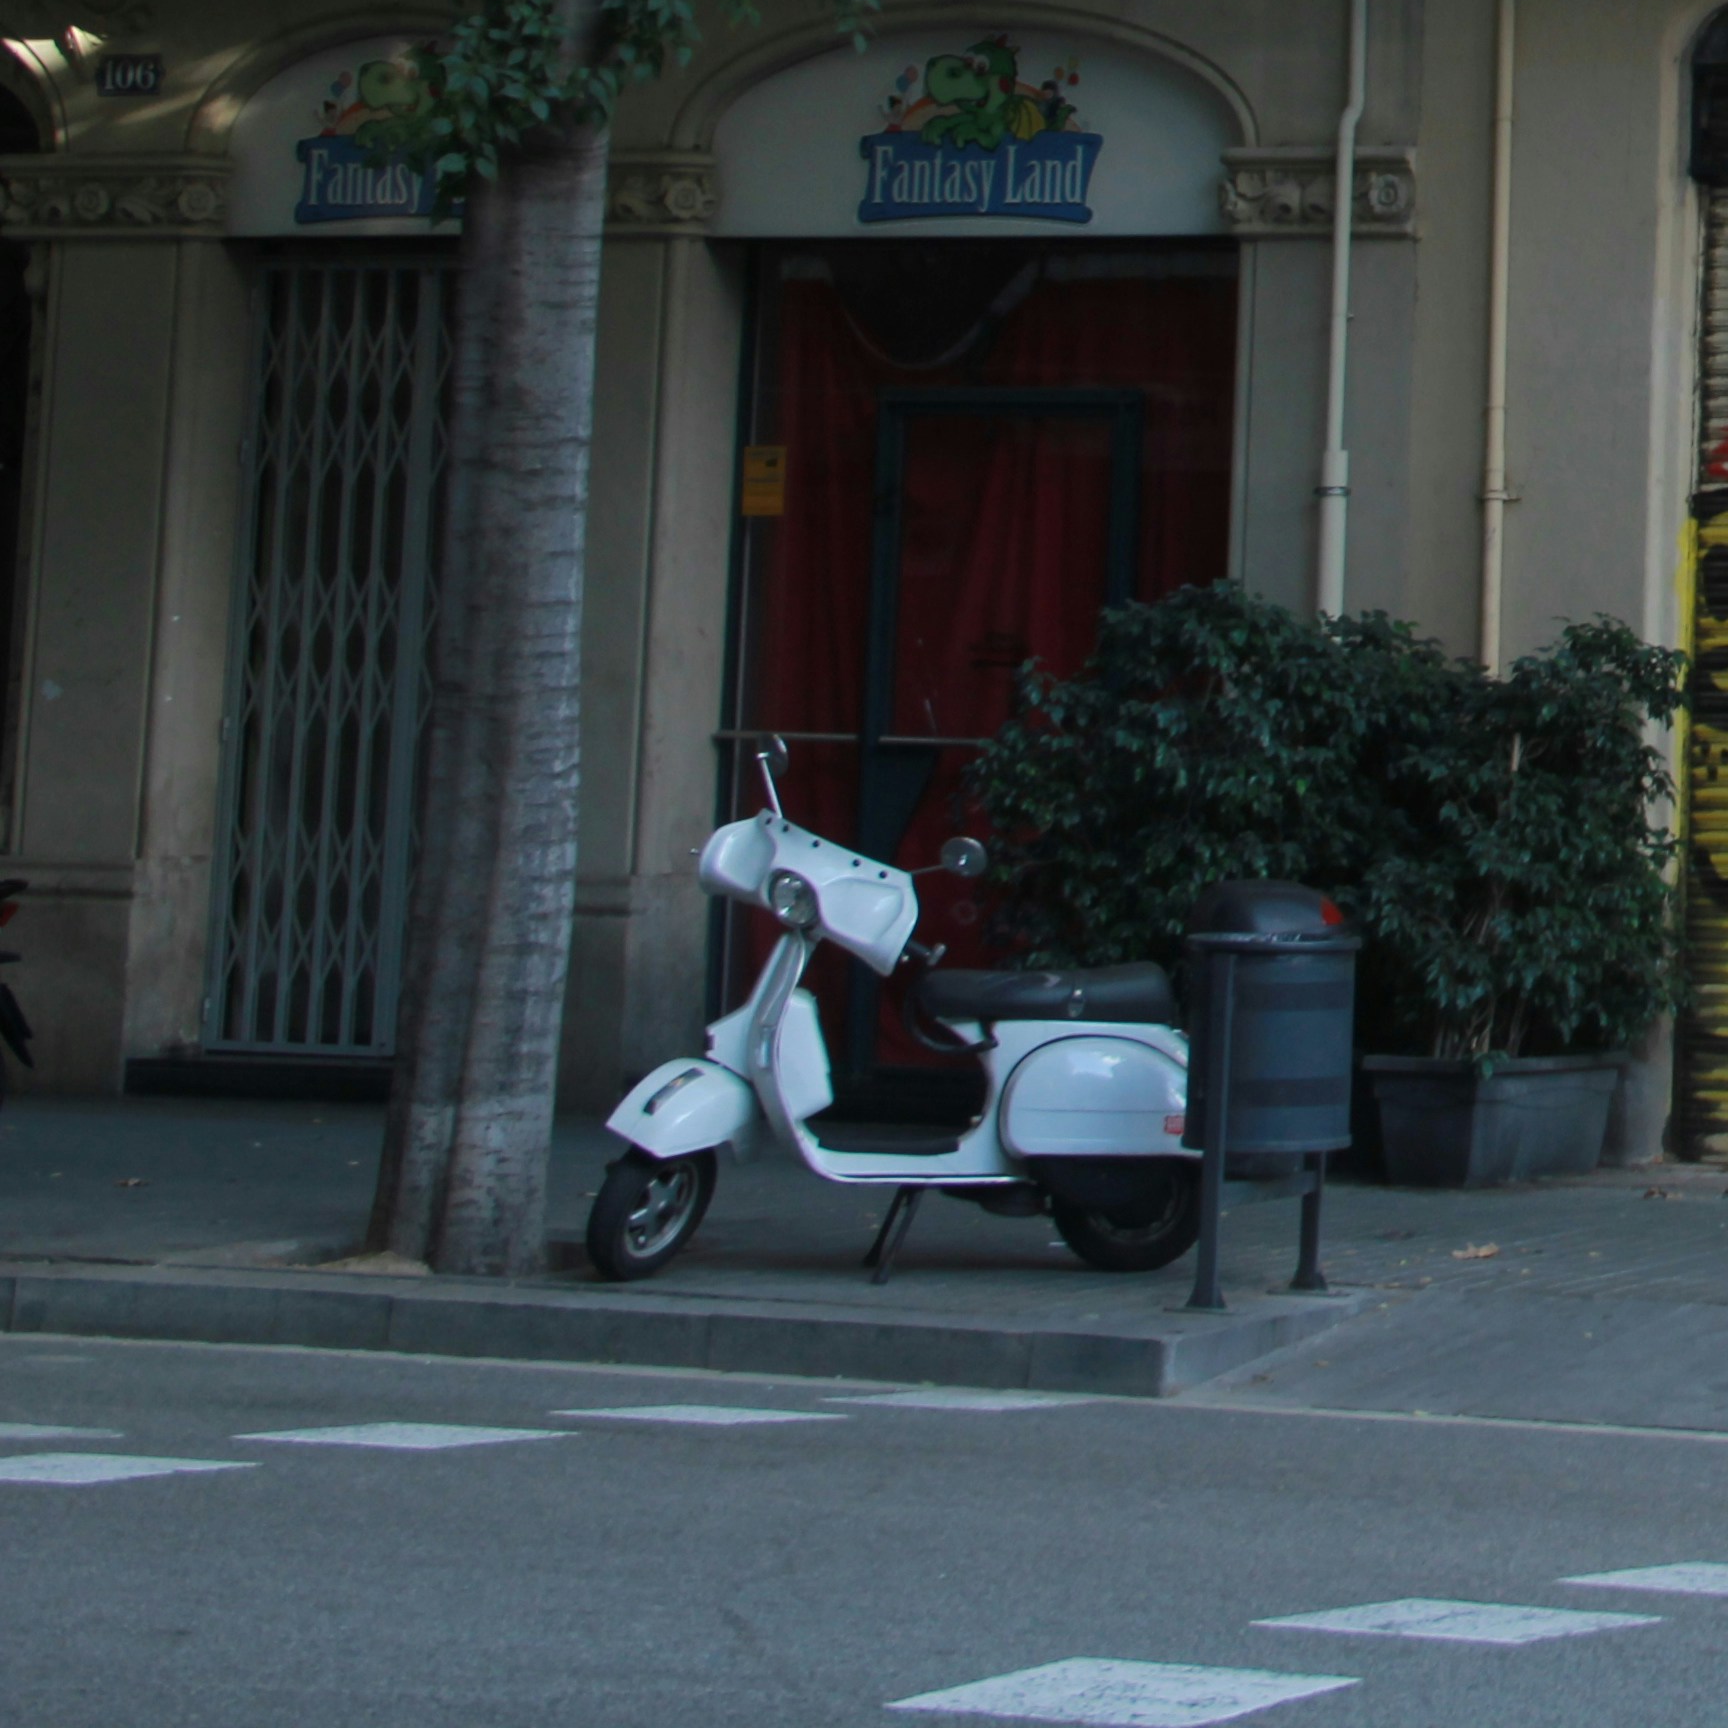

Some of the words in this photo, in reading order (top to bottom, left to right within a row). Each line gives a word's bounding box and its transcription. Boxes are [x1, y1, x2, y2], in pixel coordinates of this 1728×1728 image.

[102, 58, 157, 91] 106
[871, 144, 997, 213] Fantasy
[1004, 144, 1085, 205] Land
